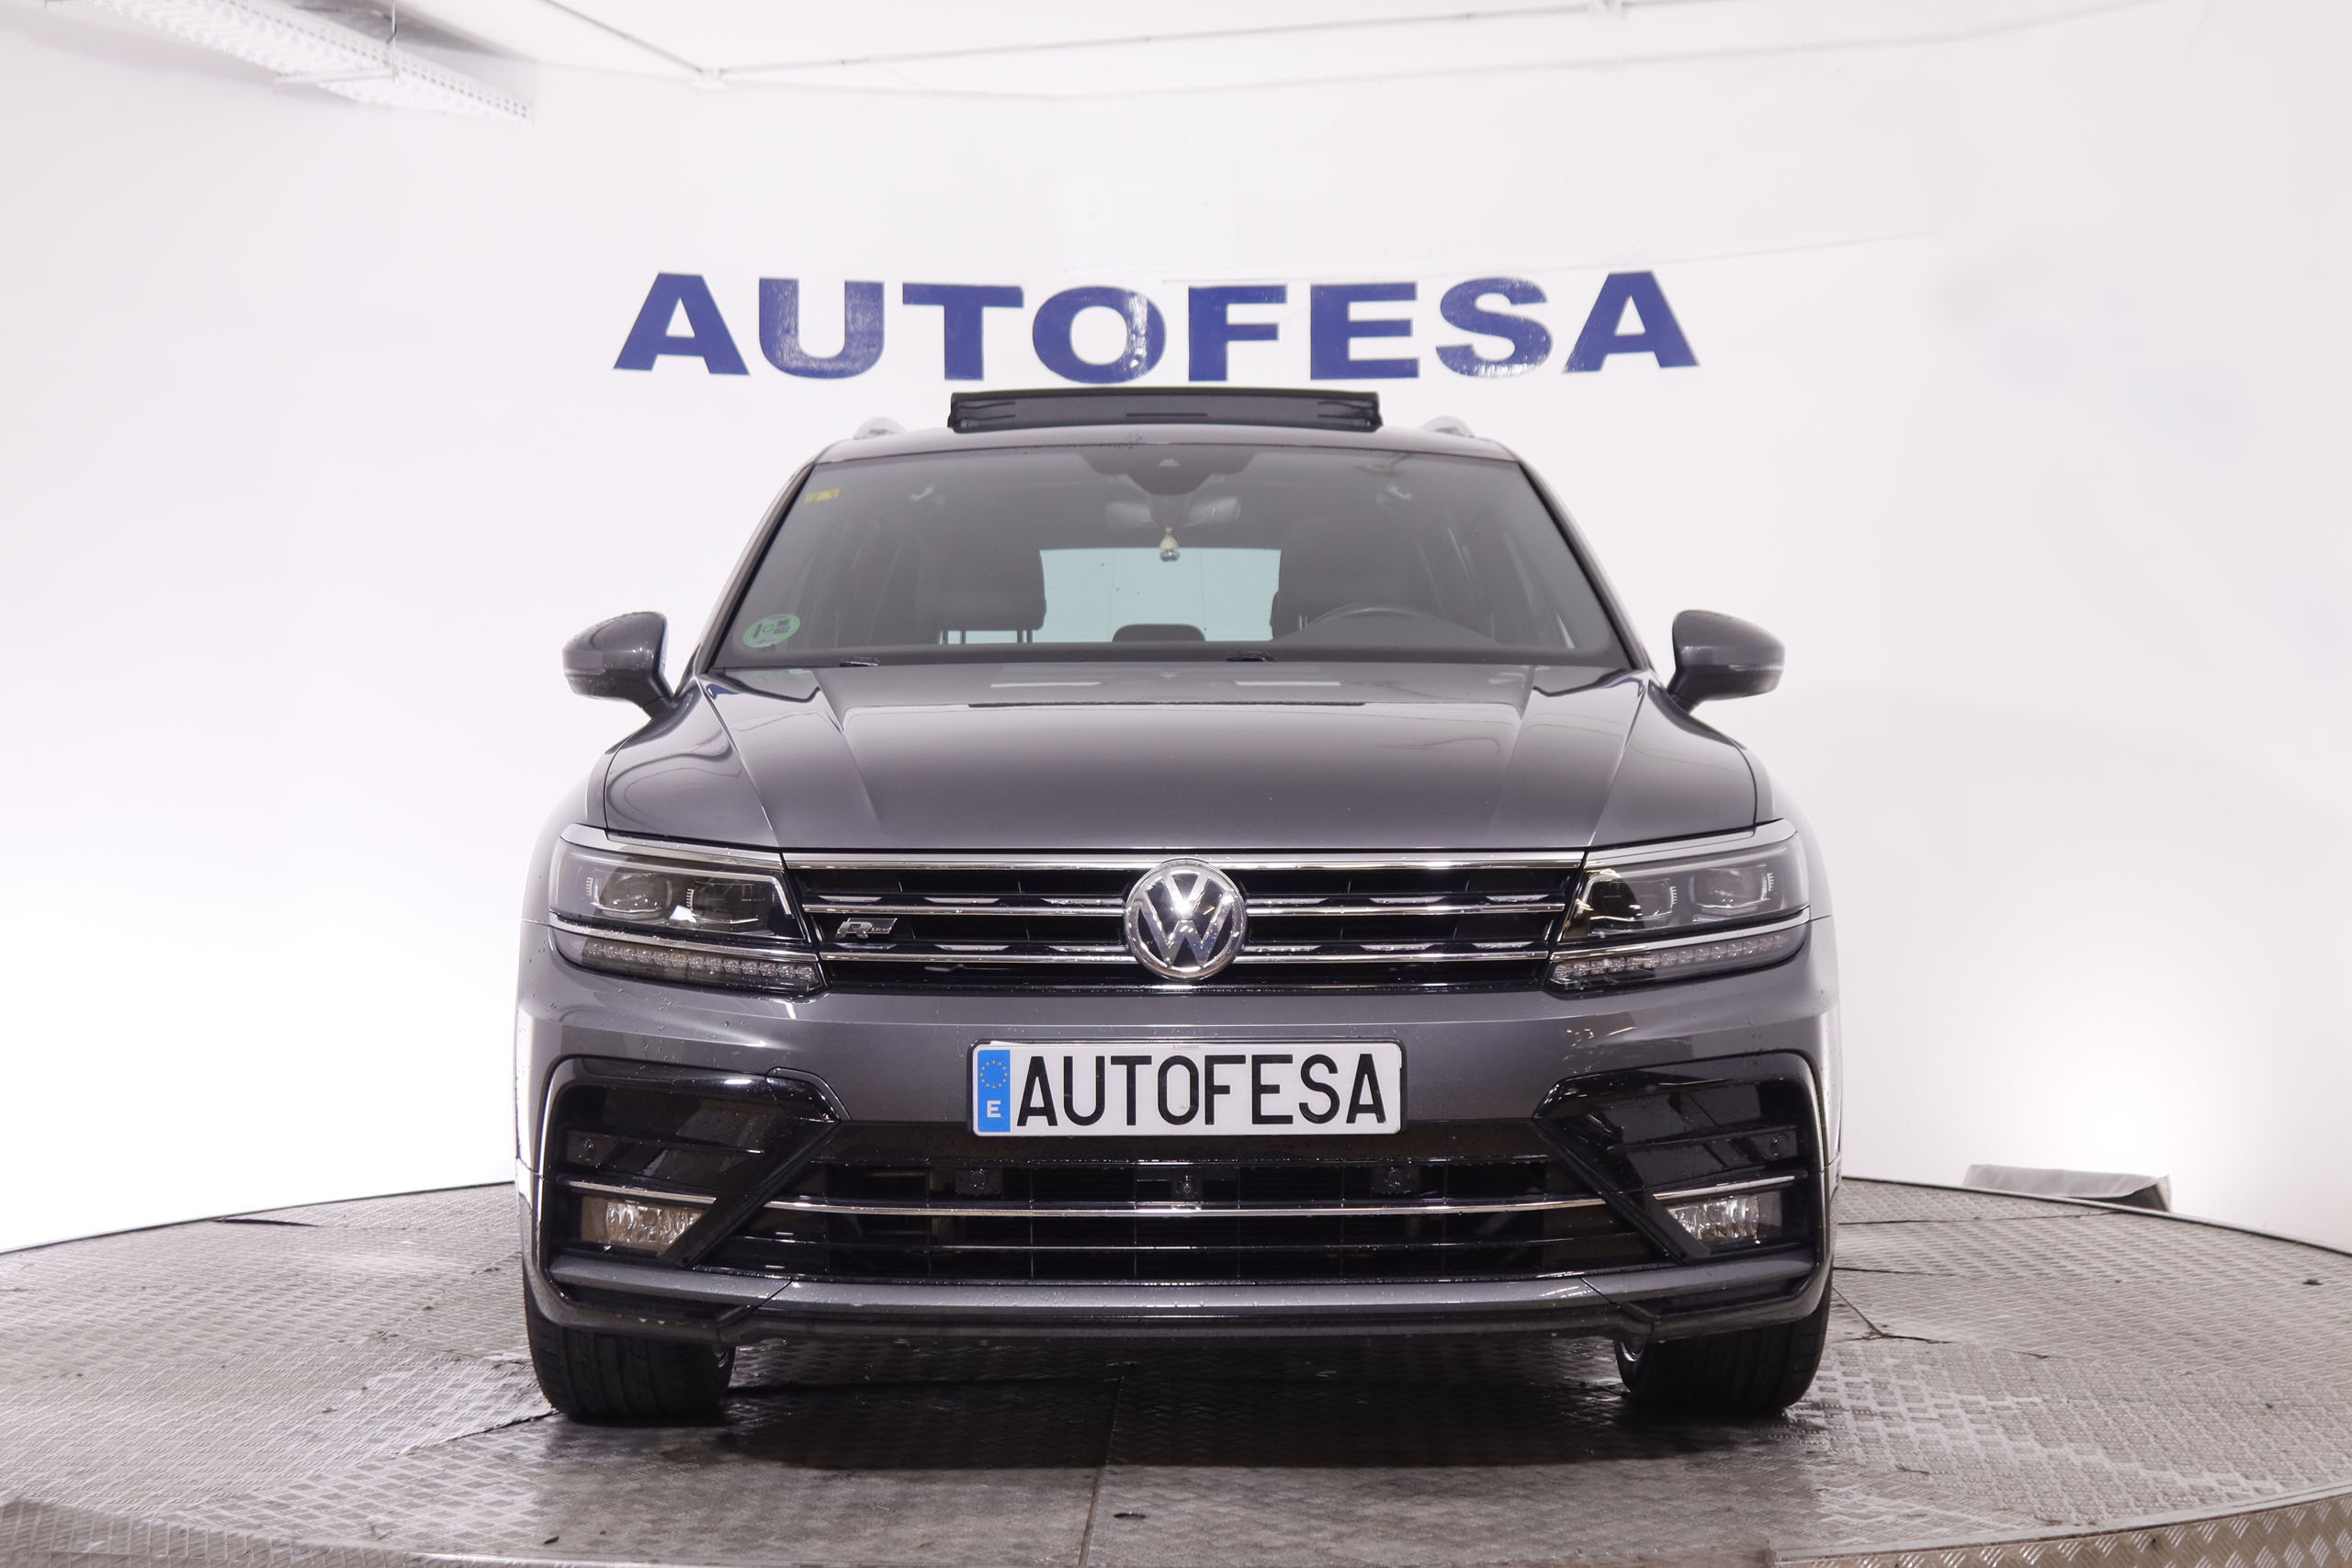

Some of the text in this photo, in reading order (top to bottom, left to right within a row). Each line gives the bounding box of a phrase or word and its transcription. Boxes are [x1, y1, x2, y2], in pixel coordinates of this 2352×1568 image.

[613, 272, 1697, 384] AUTOFESA
[986, 1100, 1001, 1118] E
[1016, 1053, 1387, 1127] AUTOFESA
